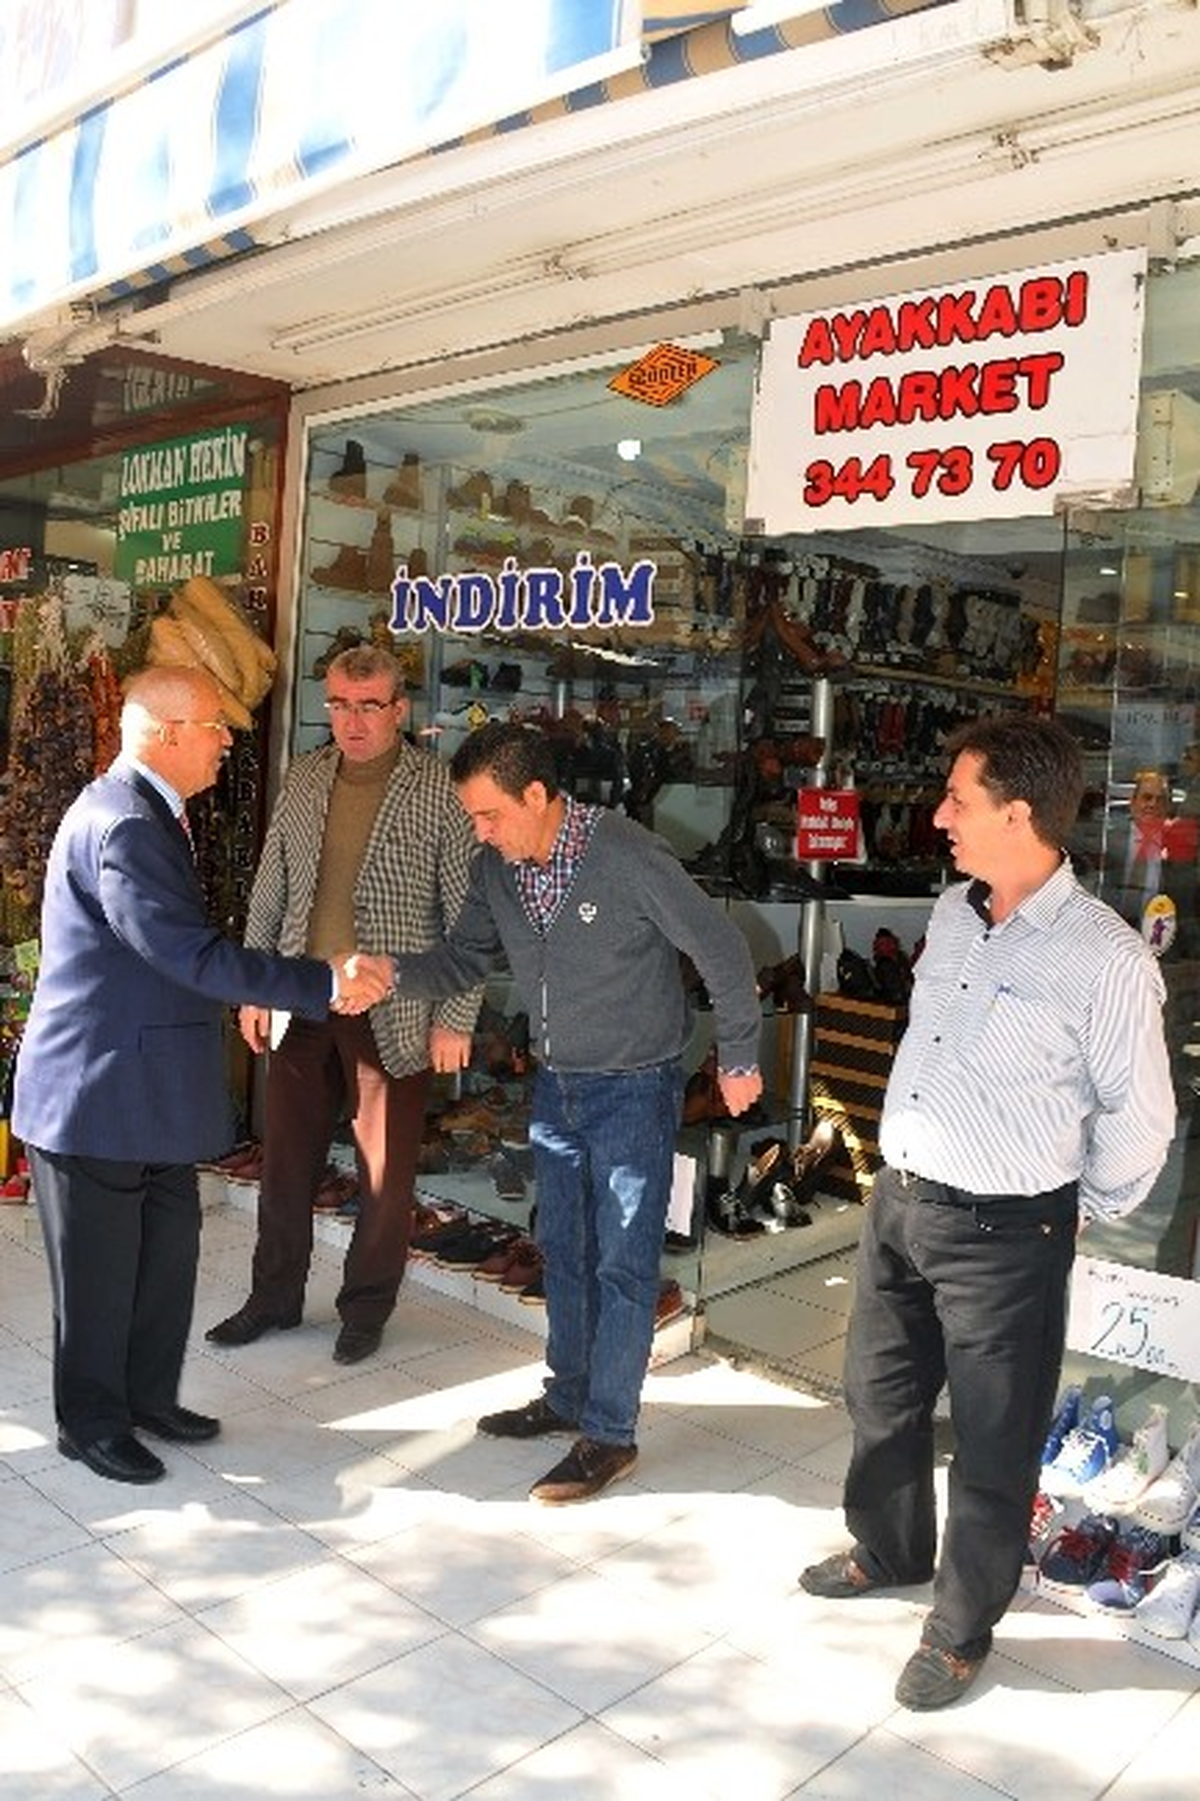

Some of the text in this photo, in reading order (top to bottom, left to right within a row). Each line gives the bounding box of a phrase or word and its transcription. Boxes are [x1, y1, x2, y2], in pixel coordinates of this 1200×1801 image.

[799, 271, 1088, 369] AYAKKABI
[814, 353, 1064, 434] MARKET
[121, 446, 188, 496] LOKMAN
[804, 438, 1060, 507] 344 73 70
[135, 551, 215, 585] BAHARAT
[162, 531, 182, 551] VE
[388, 551, 656, 633] İNDİRİM
